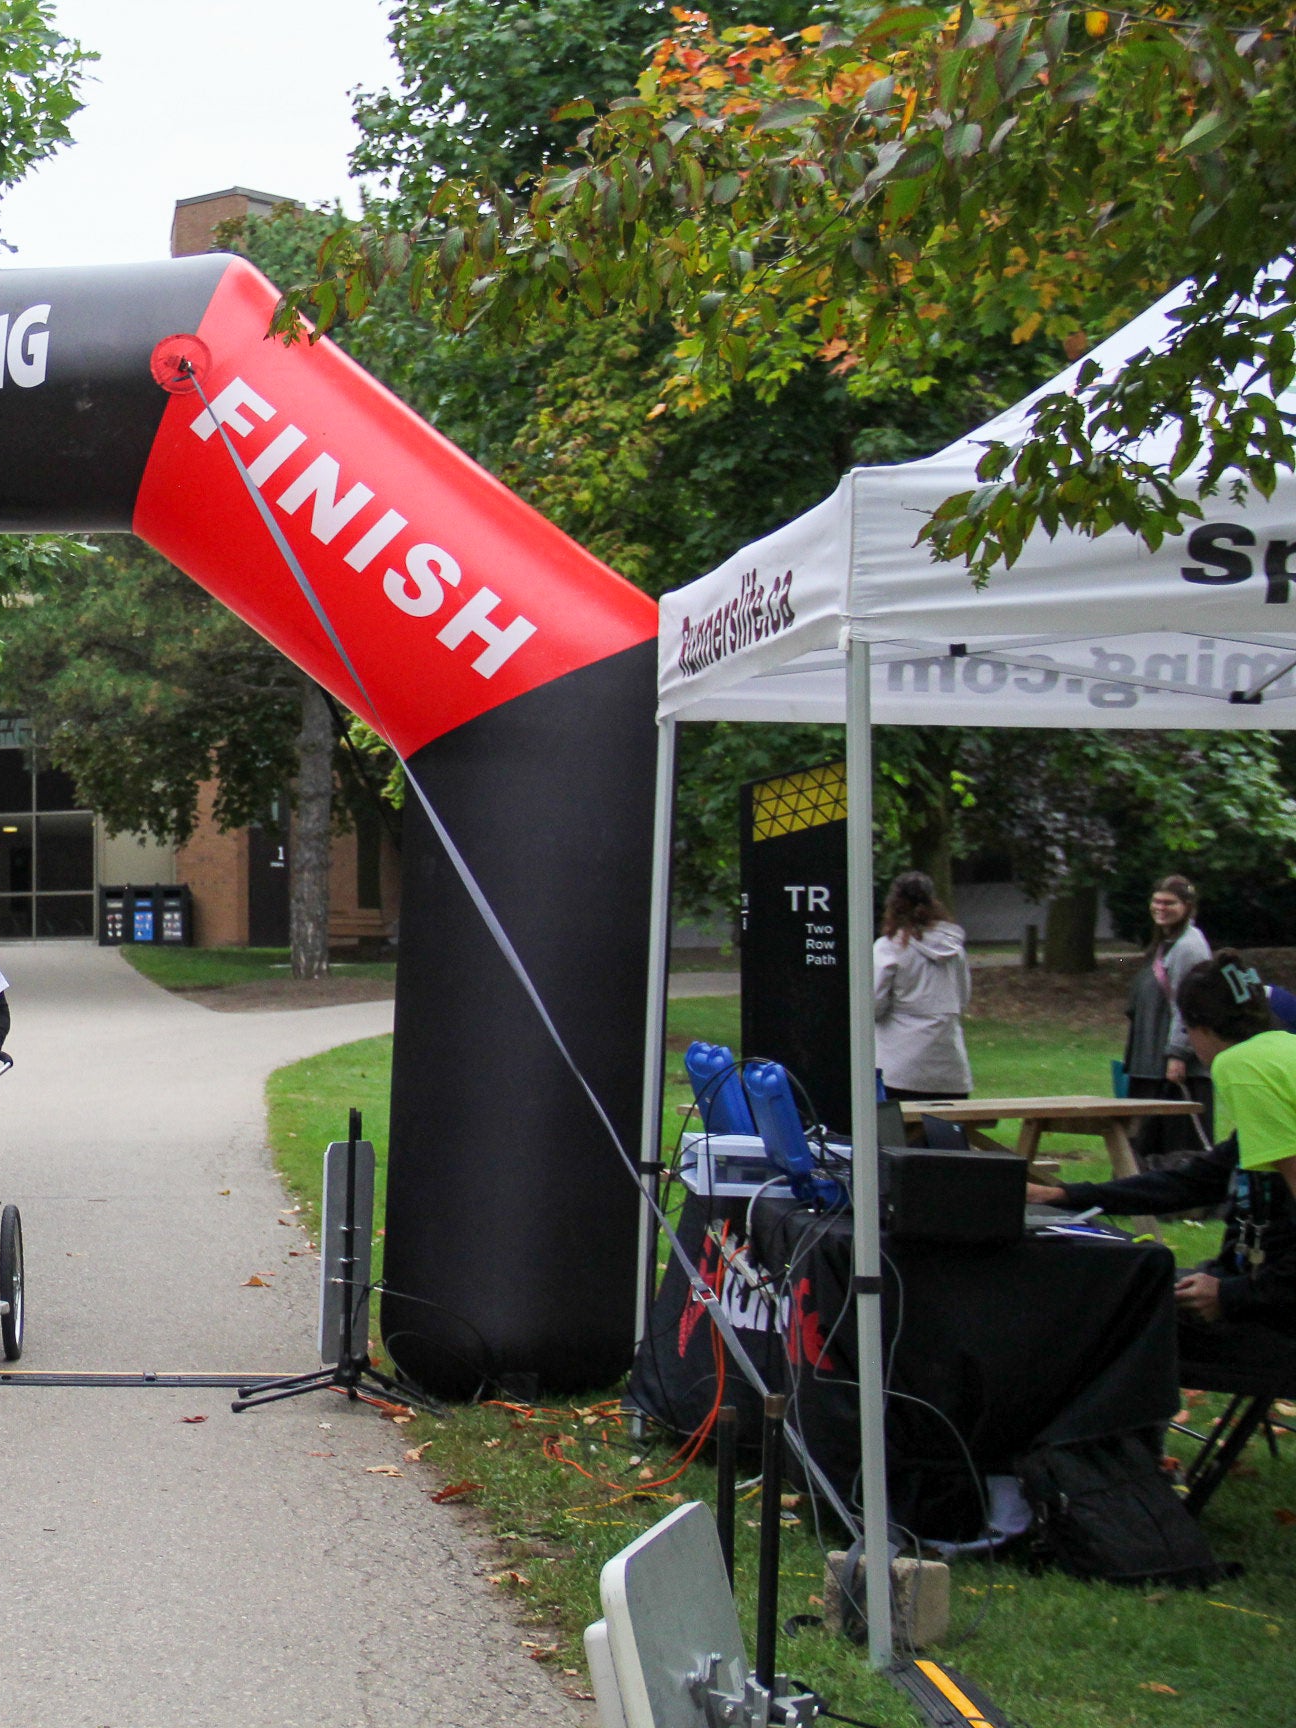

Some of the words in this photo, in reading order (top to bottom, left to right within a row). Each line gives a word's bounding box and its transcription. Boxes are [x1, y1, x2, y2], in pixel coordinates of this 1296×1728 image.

[189, 376, 538, 680] FINISH
[678, 567, 795, 678] Runnerslife.ca
[784, 886, 830, 912] TR
[805, 923, 834, 934] Two
[805, 939, 835, 950] Row
[805, 954, 836, 965] Path
